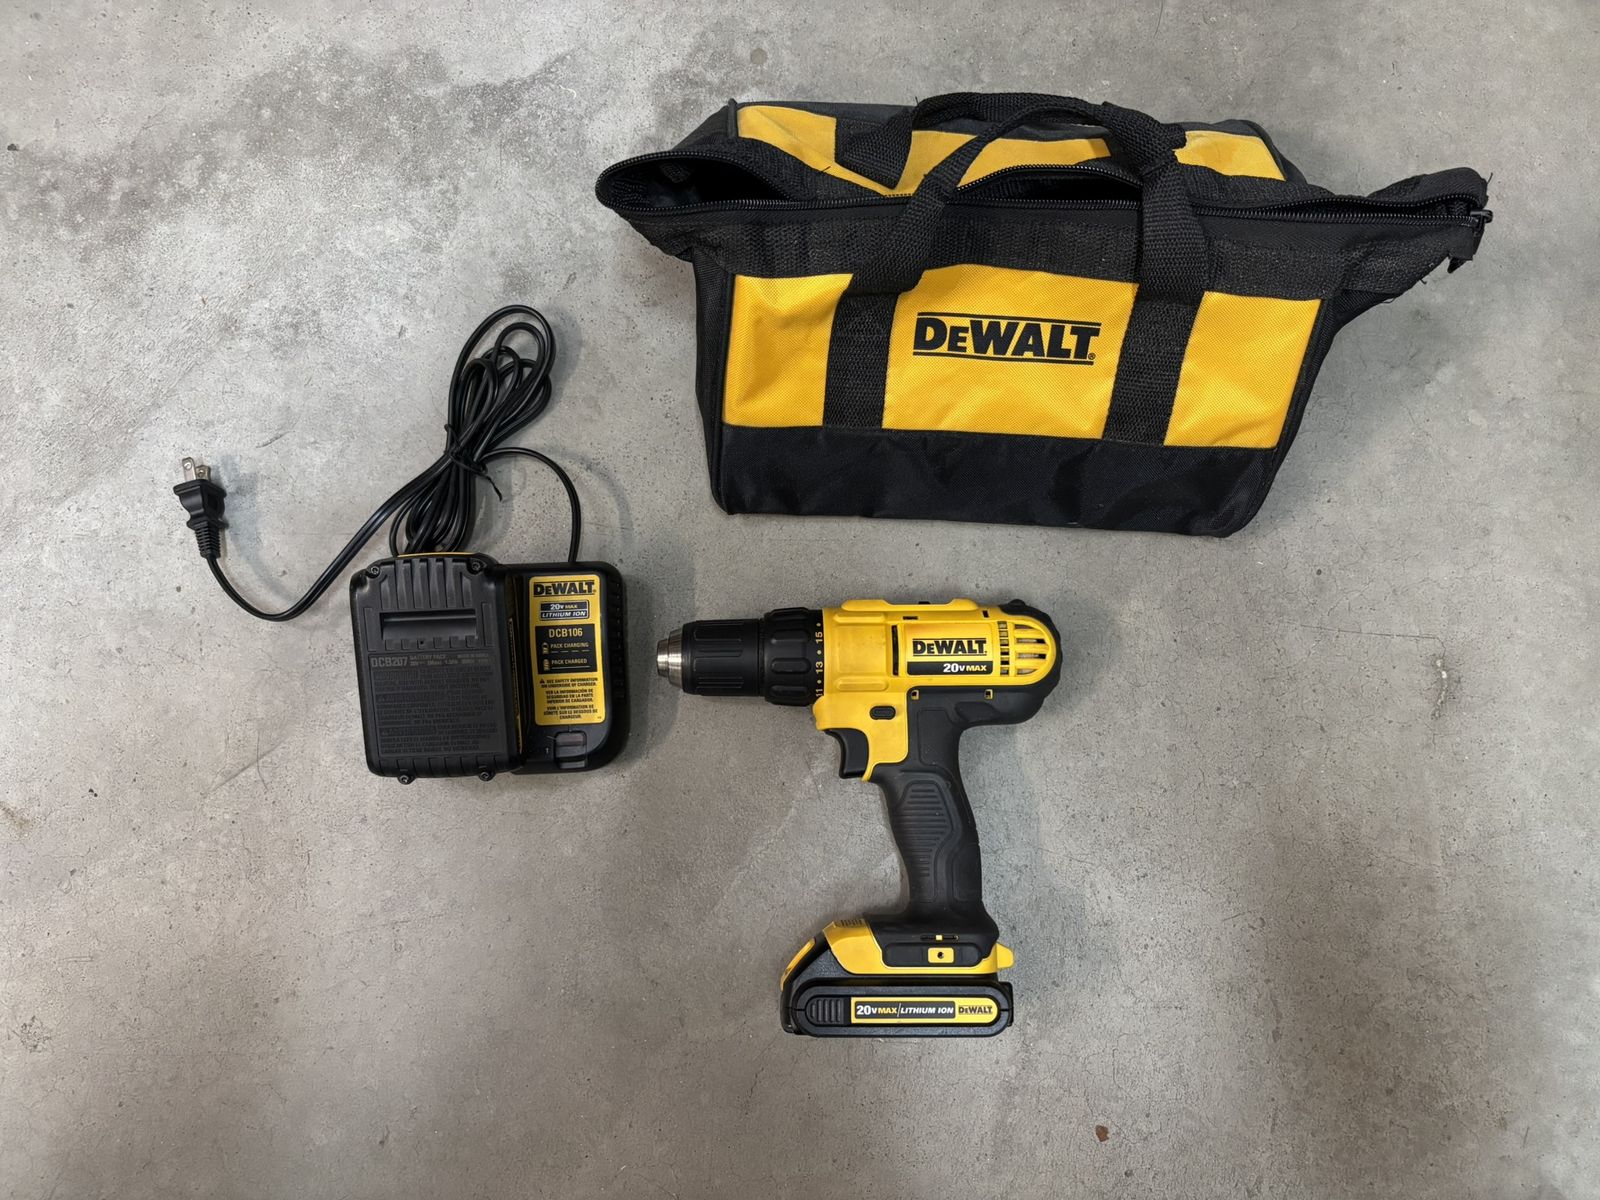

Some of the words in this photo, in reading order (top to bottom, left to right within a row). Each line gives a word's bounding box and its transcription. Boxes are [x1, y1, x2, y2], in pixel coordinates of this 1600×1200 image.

[913, 317, 1101, 360] DEWALT
[533, 581, 595, 597] DEWALT
[548, 628, 583, 638] DCB106
[815, 631, 823, 644] 15
[912, 640, 987, 655] DEWALT
[371, 656, 408, 668] DCB207
[815, 661, 823, 675] 13
[966, 664, 987, 672] MAX
[877, 1006, 898, 1014] MAX
[899, 1006, 936, 1014] LITHIUM
[937, 1006, 954, 1014] ION
[958, 1005, 993, 1015] DEWALT
